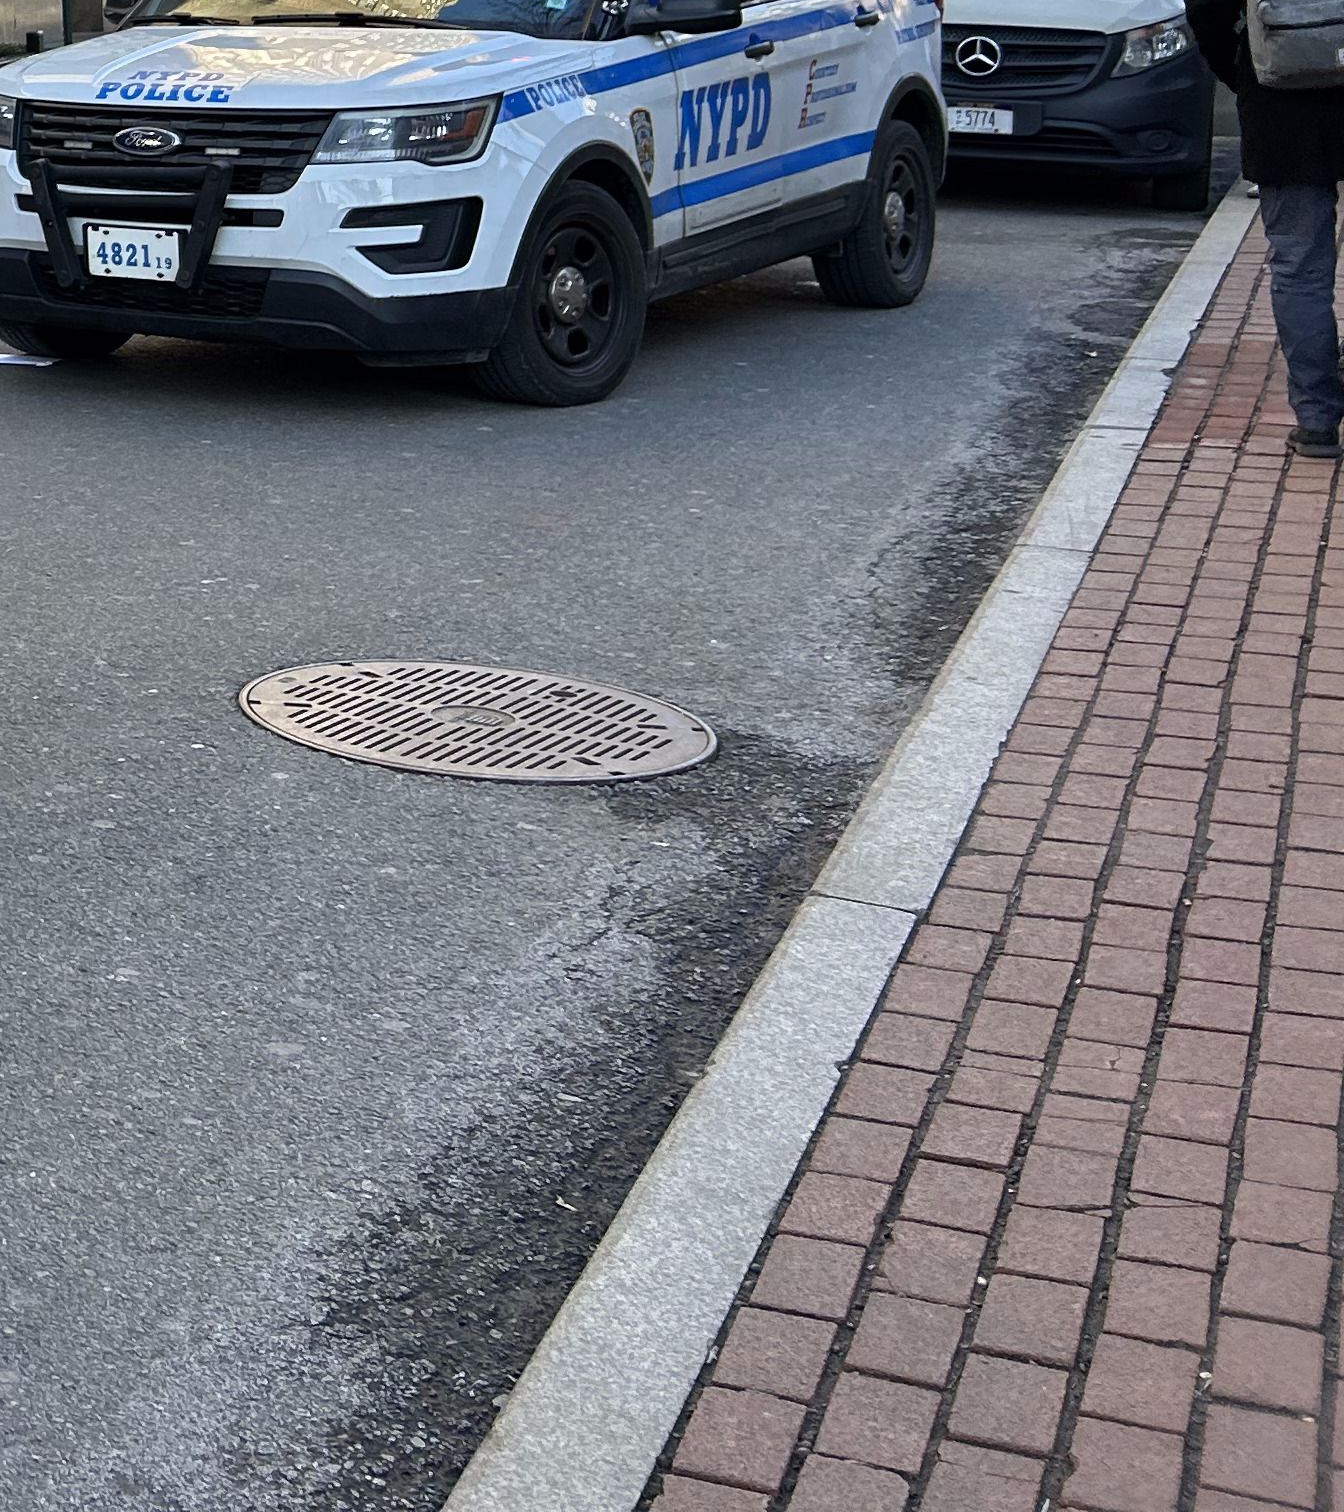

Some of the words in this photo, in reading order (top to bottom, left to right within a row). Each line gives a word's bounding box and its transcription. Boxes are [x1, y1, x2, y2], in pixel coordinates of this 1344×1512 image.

[126, 70, 226, 82] NYPD
[95, 81, 234, 104] POLICE
[525, 74, 587, 112] POLICE
[673, 71, 772, 171] NYPD
[96, 241, 151, 268] 4821
[155, 256, 173, 270] 19
